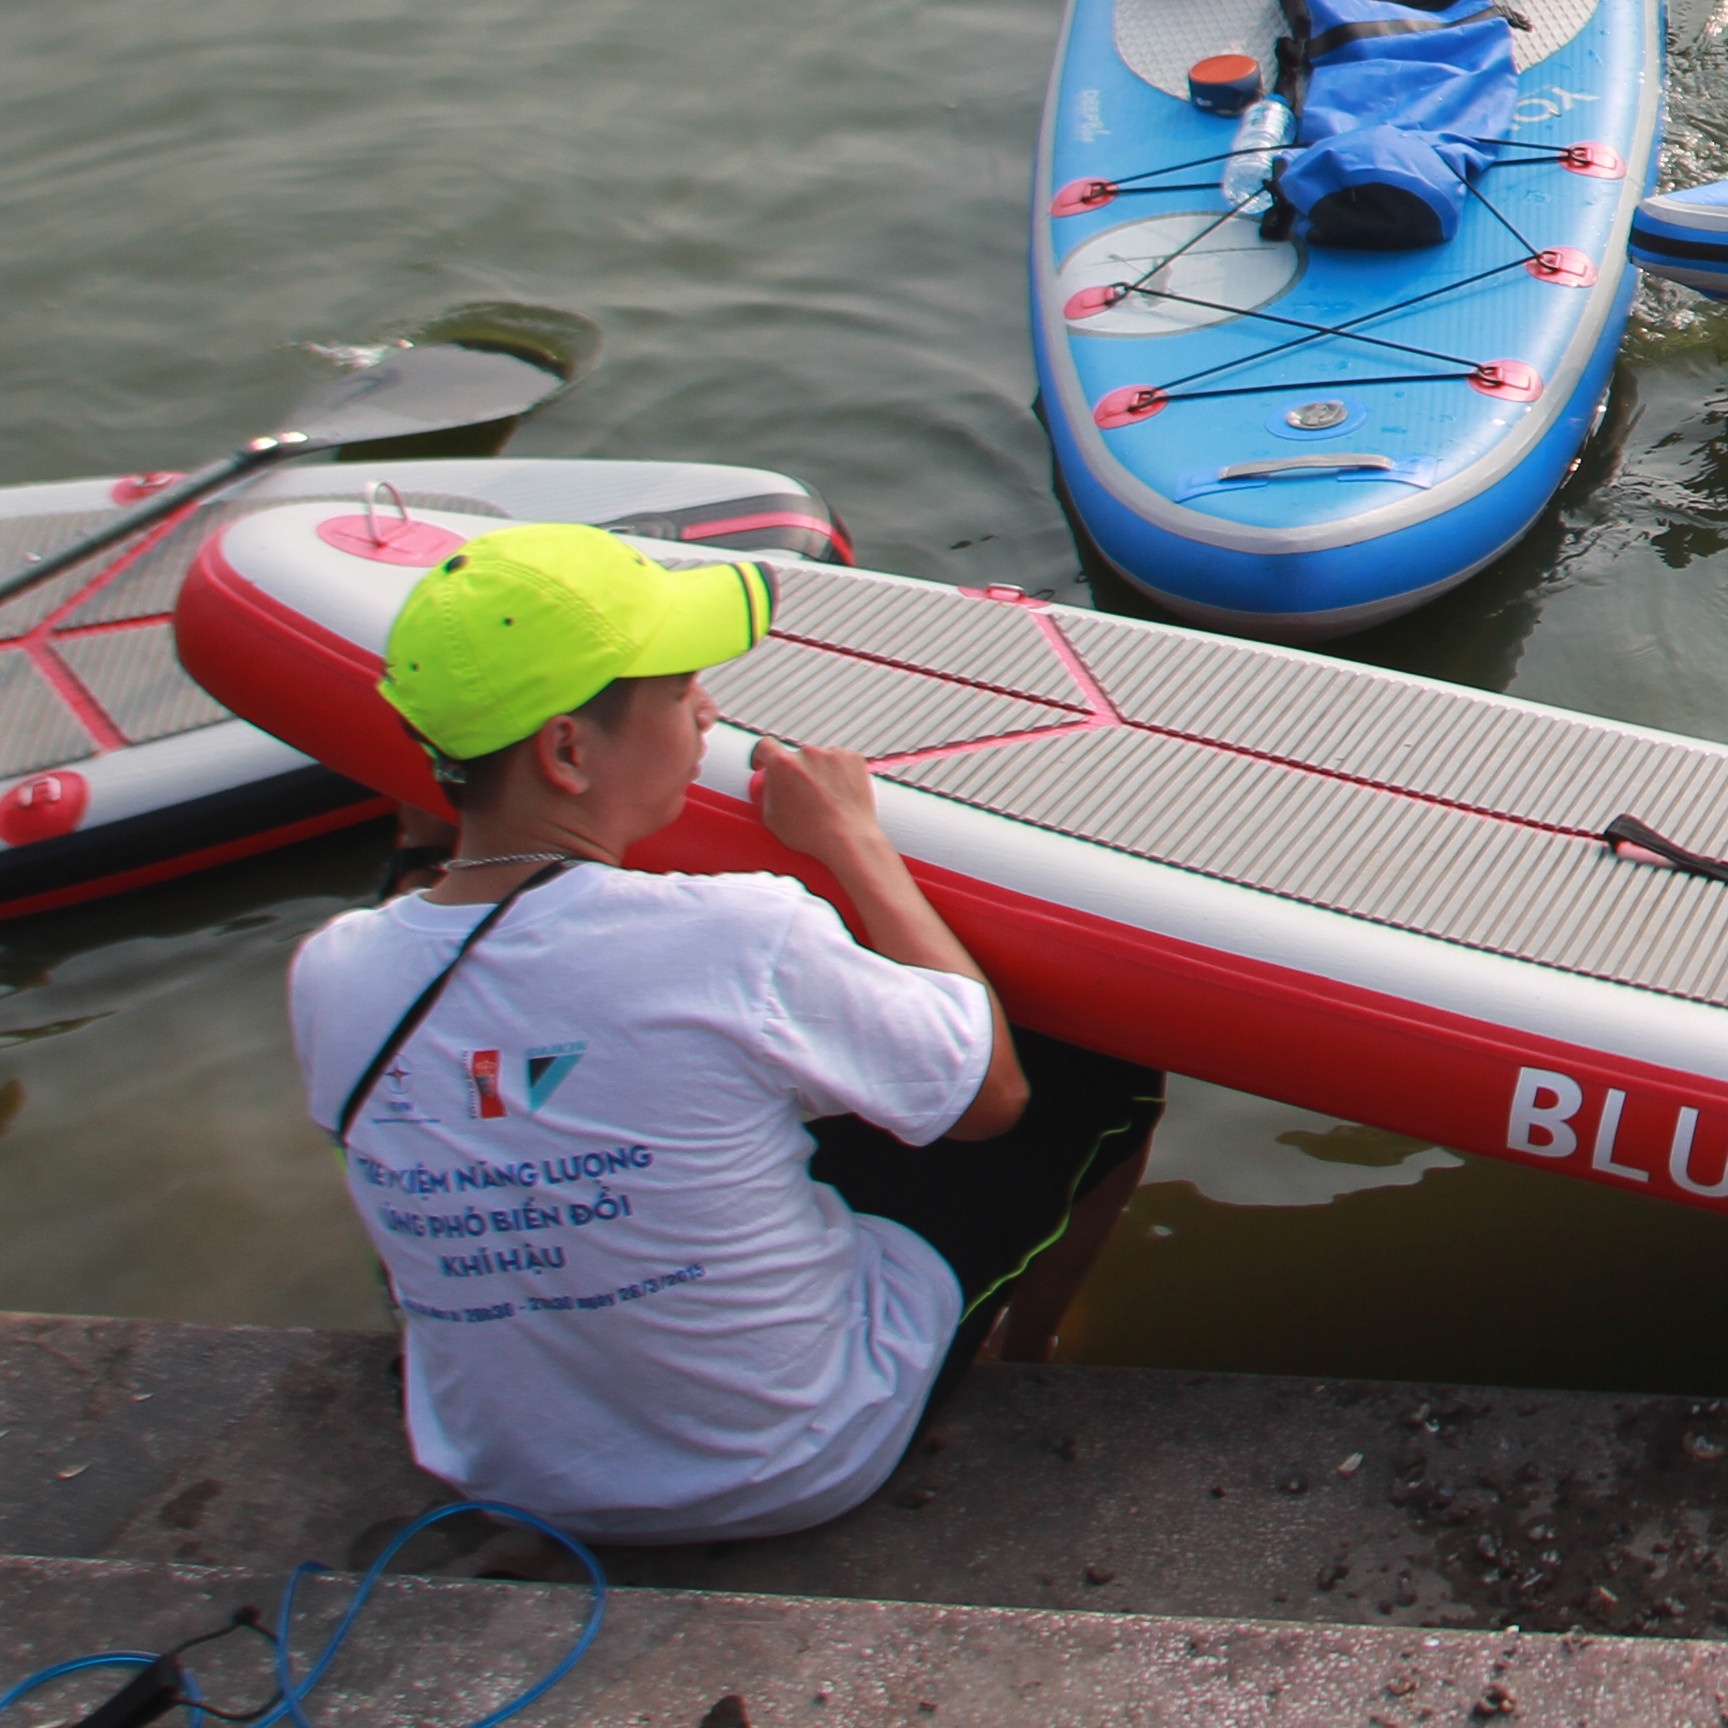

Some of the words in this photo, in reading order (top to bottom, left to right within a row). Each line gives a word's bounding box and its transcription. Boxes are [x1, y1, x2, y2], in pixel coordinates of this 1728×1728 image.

[428, 1205, 487, 1238] PHÓ
[490, 1196, 564, 1232] BIẾN
[568, 1185, 634, 1226] ĐỔI
[440, 1246, 496, 1277] KHÍ
[497, 1242, 567, 1275] HẬU
